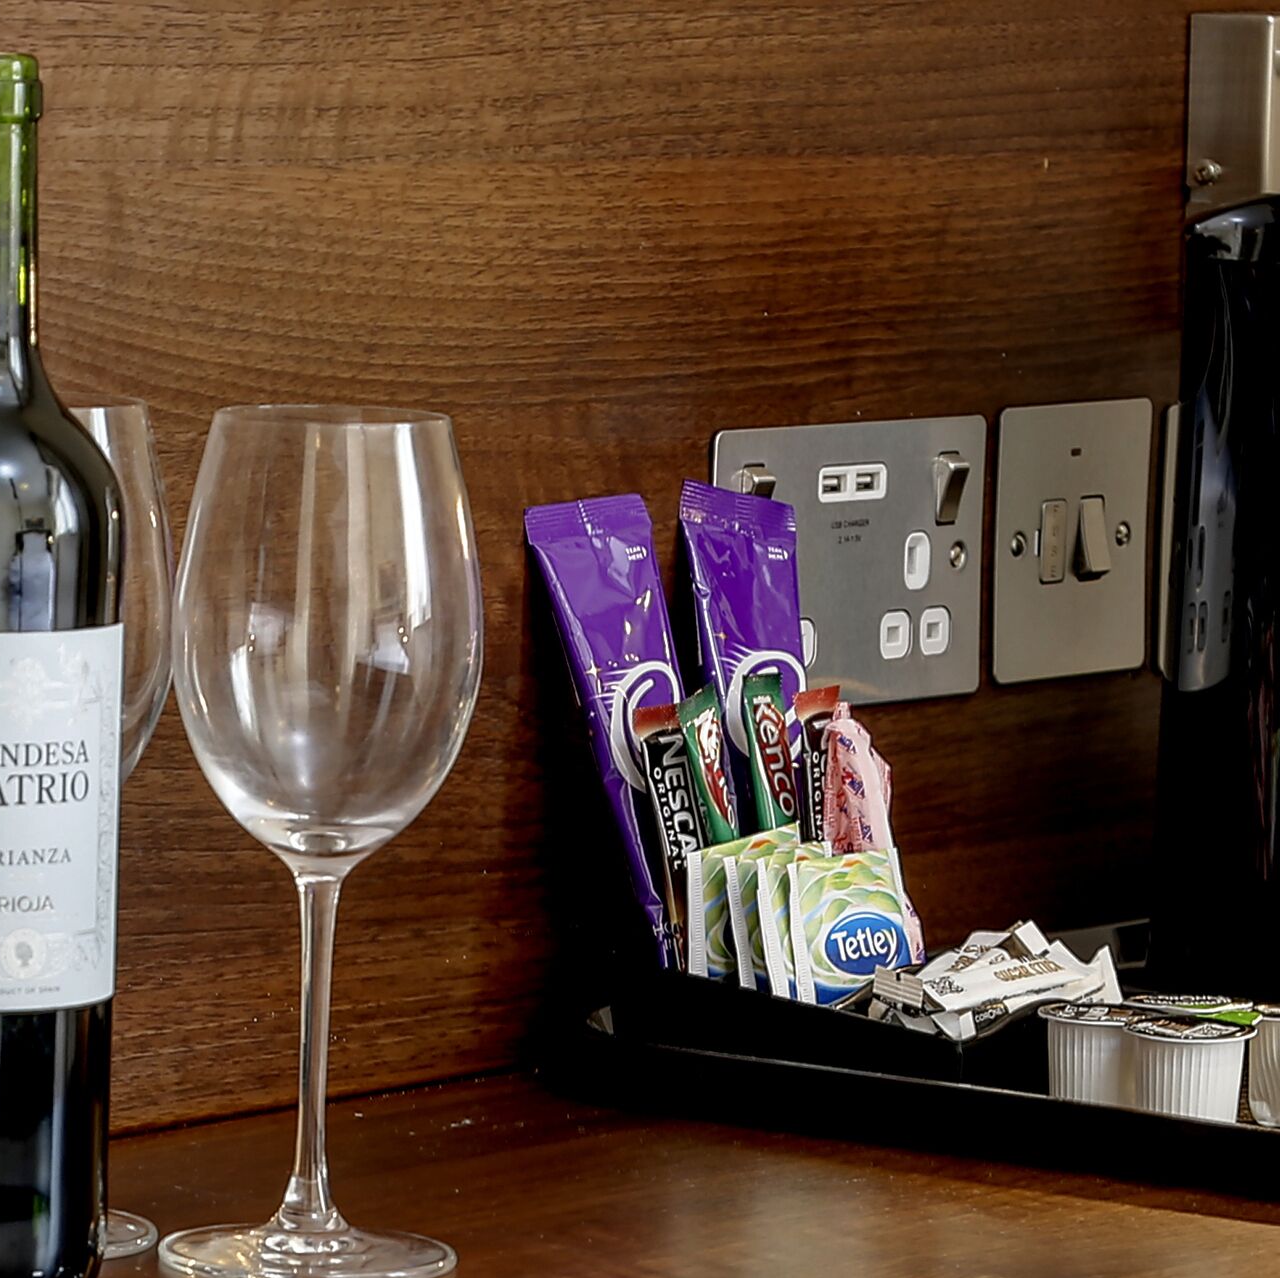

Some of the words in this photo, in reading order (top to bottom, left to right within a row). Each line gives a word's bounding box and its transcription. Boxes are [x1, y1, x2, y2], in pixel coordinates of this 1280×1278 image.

[753, 695, 795, 818] Kenco
[653, 766, 683, 871] ORIGINAL
[830, 926, 898, 964] Tetley
